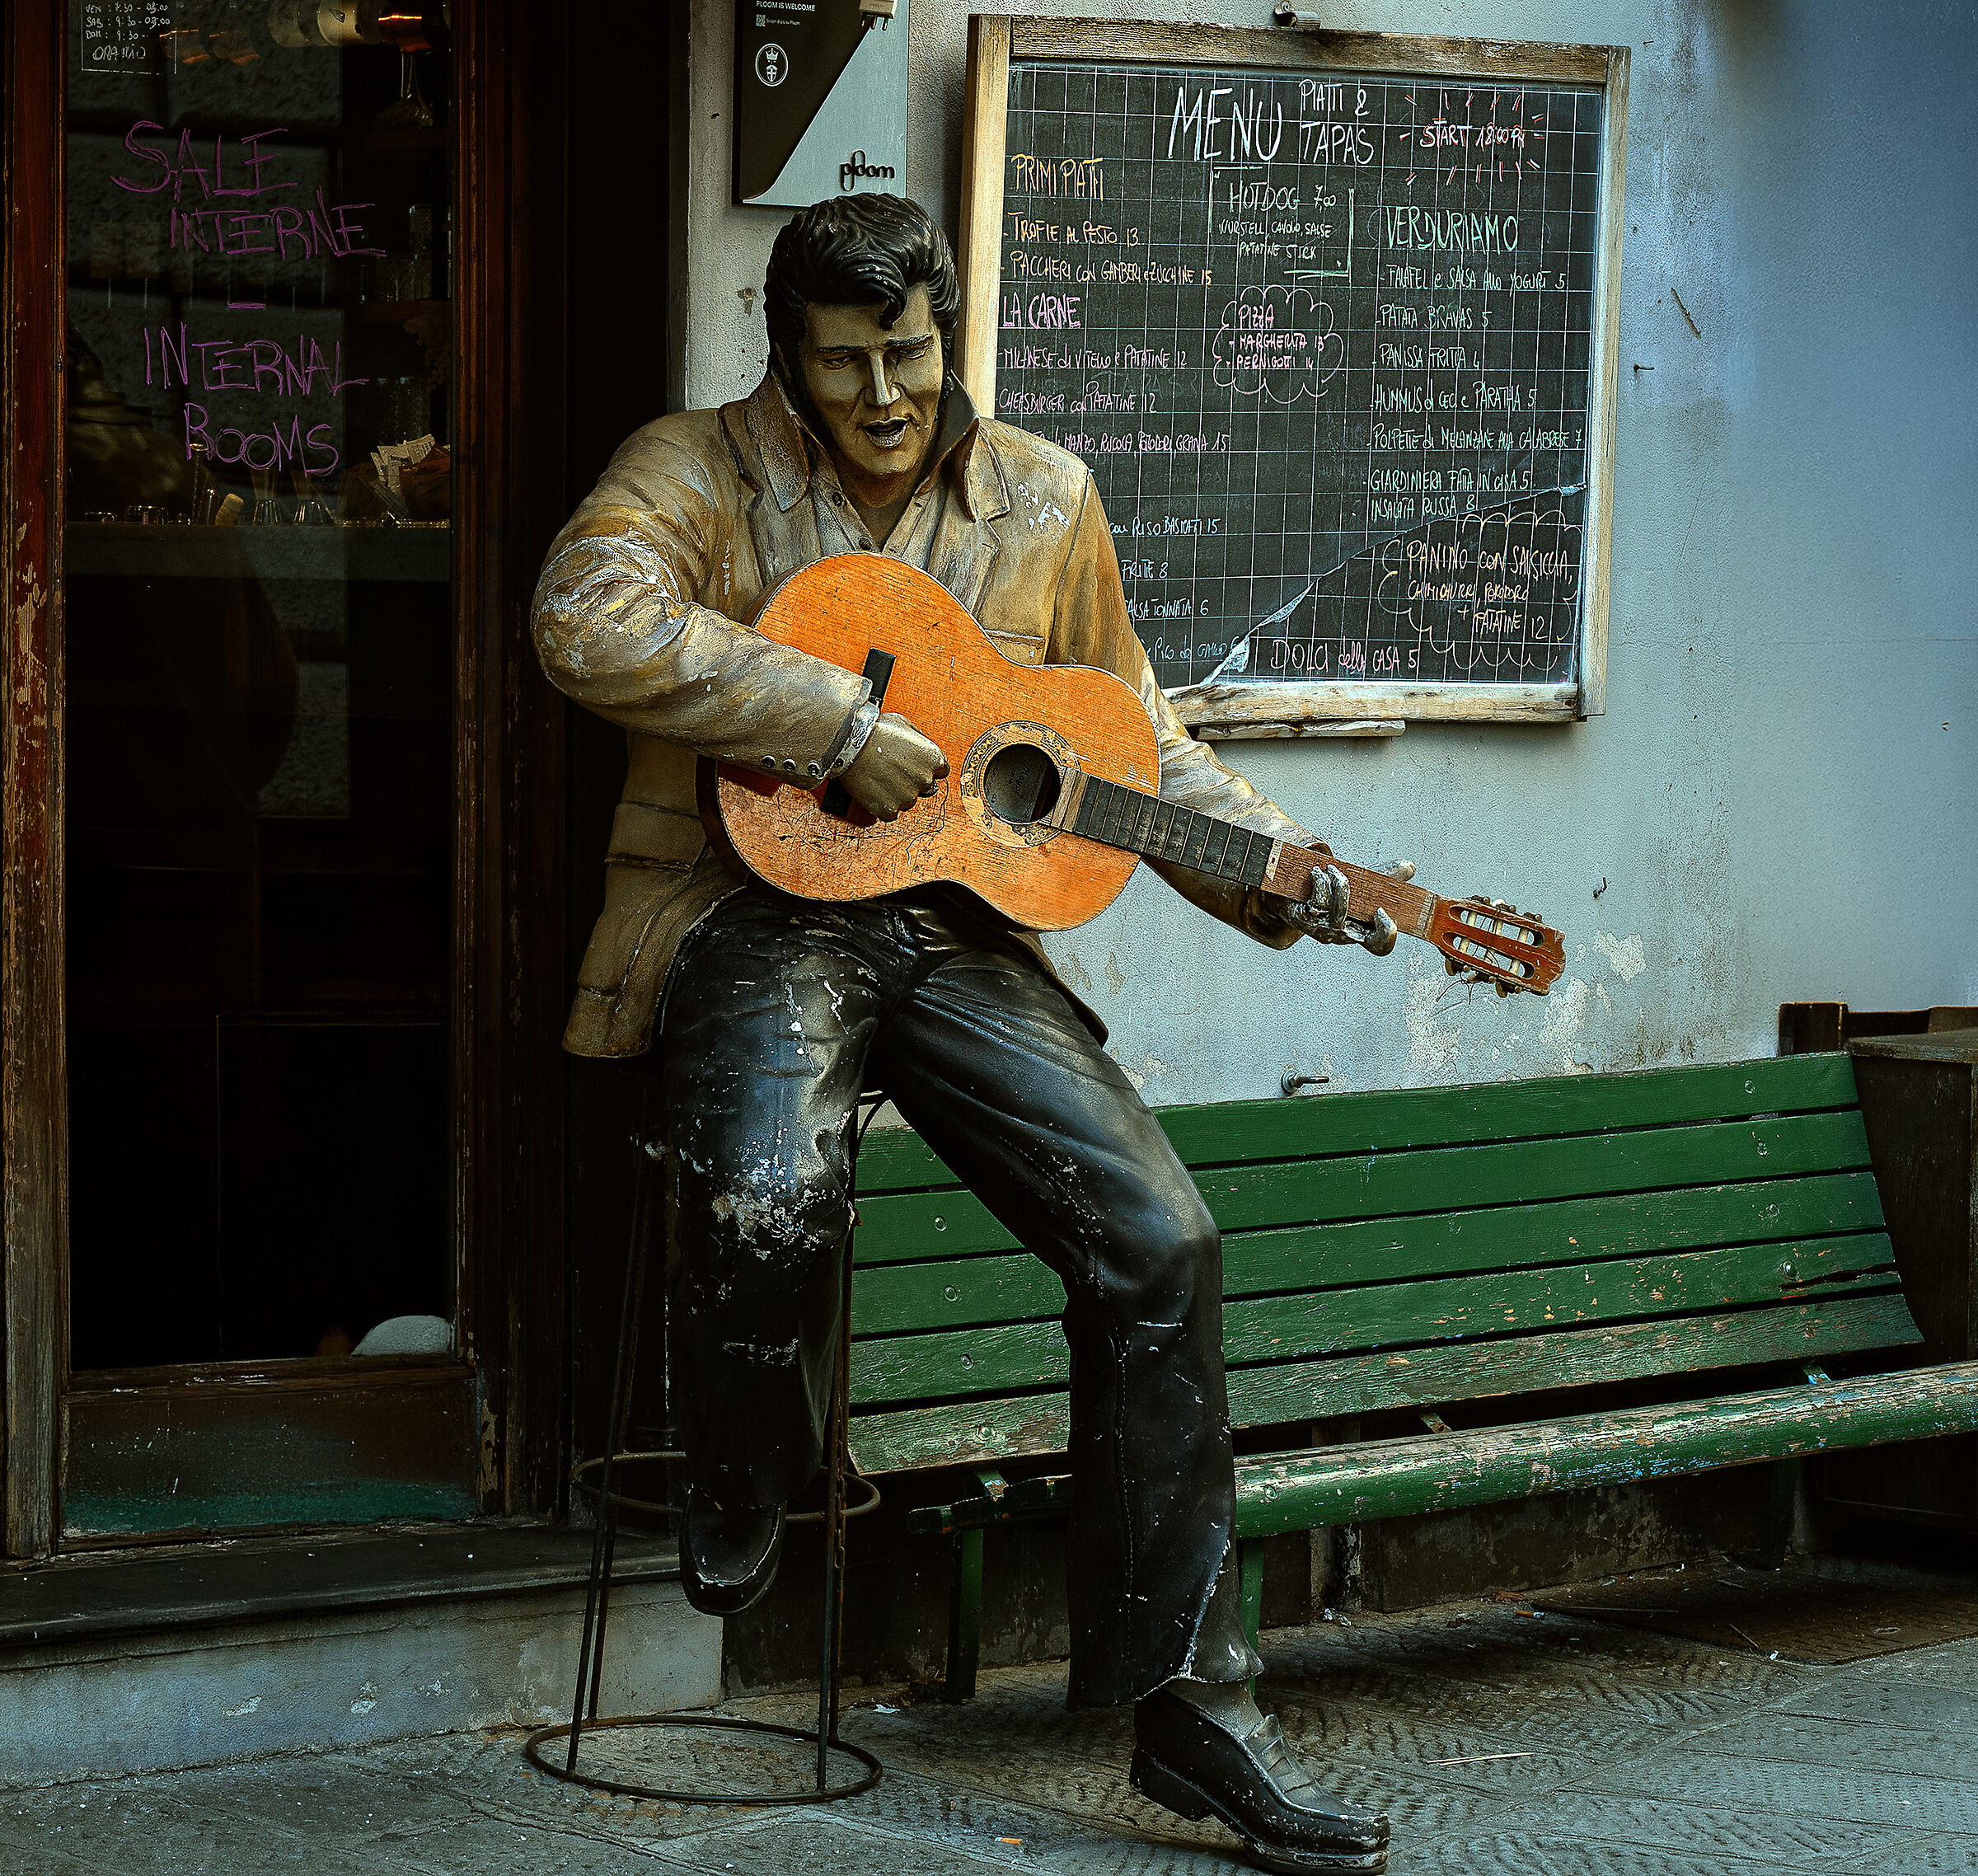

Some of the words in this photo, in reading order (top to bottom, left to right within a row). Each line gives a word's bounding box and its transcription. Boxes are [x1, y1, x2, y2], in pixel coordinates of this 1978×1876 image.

[785, 2, 815, 12] WELCOME
[1299, 79, 1343, 112] PIATTI
[1168, 86, 1282, 162] MENU
[1419, 117, 1473, 147] START
[1301, 122, 1375, 165] TAPAS
[110, 120, 298, 204] SALE
[839, 149, 896, 192] ploom
[1010, 153, 1057, 196] PRIMI
[171, 185, 387, 260] INTERNE
[1007, 211, 1059, 242] TROFIE
[1066, 225, 1080, 245] AL
[1082, 220, 1118, 244] PESTO
[1127, 227, 1139, 247] 13
[1305, 222, 1333, 238] SALSE
[1385, 205, 1518, 256] VERDURIAMO
[1010, 250, 1071, 282] PACCHERI
[1101, 260, 1141, 284] GAMBERI
[1201, 269, 1212, 286] 15
[1385, 264, 1429, 289] FALAFEL
[1446, 265, 1477, 289] SALSA
[1510, 268, 1552, 298] YOGURT
[1554, 272, 1567, 289] 5
[1002, 291, 1021, 328] LA
[1029, 292, 1081, 329] CARNE
[1238, 303, 1275, 330] PIZZA
[1380, 303, 1418, 328] PATATA
[1424, 305, 1473, 330] BRAVAS
[1481, 311, 1493, 328] 5
[1004, 345, 1058, 369] MILANESE
[1123, 344, 1171, 368] PATATINE
[1177, 350, 1188, 367] 12
[1240, 332, 1308, 351] MARGHERITA
[1379, 343, 1423, 368] PANISSA
[144, 321, 370, 396] INTERNAL
[1143, 392, 1157, 413] 12
[1375, 382, 1423, 417] HUMMUS
[1473, 381, 1521, 412] PARATHA
[1527, 387, 1538, 407] 5
[184, 402, 339, 478] ROOMS
[1212, 431, 1230, 452] 15
[1372, 423, 1424, 450] POLPETTE
[1519, 426, 1570, 450] CALABRESE
[1370, 468, 1442, 492] GIARDINIERA
[1519, 470, 1531, 490] 5
[1371, 496, 1415, 523] INSALATA
[1422, 495, 1457, 517] RUSSA
[1465, 494, 1475, 511] 8
[1163, 515, 1202, 536] BASMATI
[1207, 518, 1221, 534] 15
[1121, 559, 1155, 579] FRITTE
[1159, 561, 1169, 579] 8
[1407, 539, 1468, 574] PANINO
[1151, 598, 1192, 618] TONNATA
[1199, 599, 1209, 616] 6
[1474, 608, 1522, 635] PATATINE
[1531, 616, 1548, 640] 12
[1271, 639, 1329, 673] DOLCI
[1372, 645, 1400, 672] CASA
[1408, 648, 1419, 668] 5
